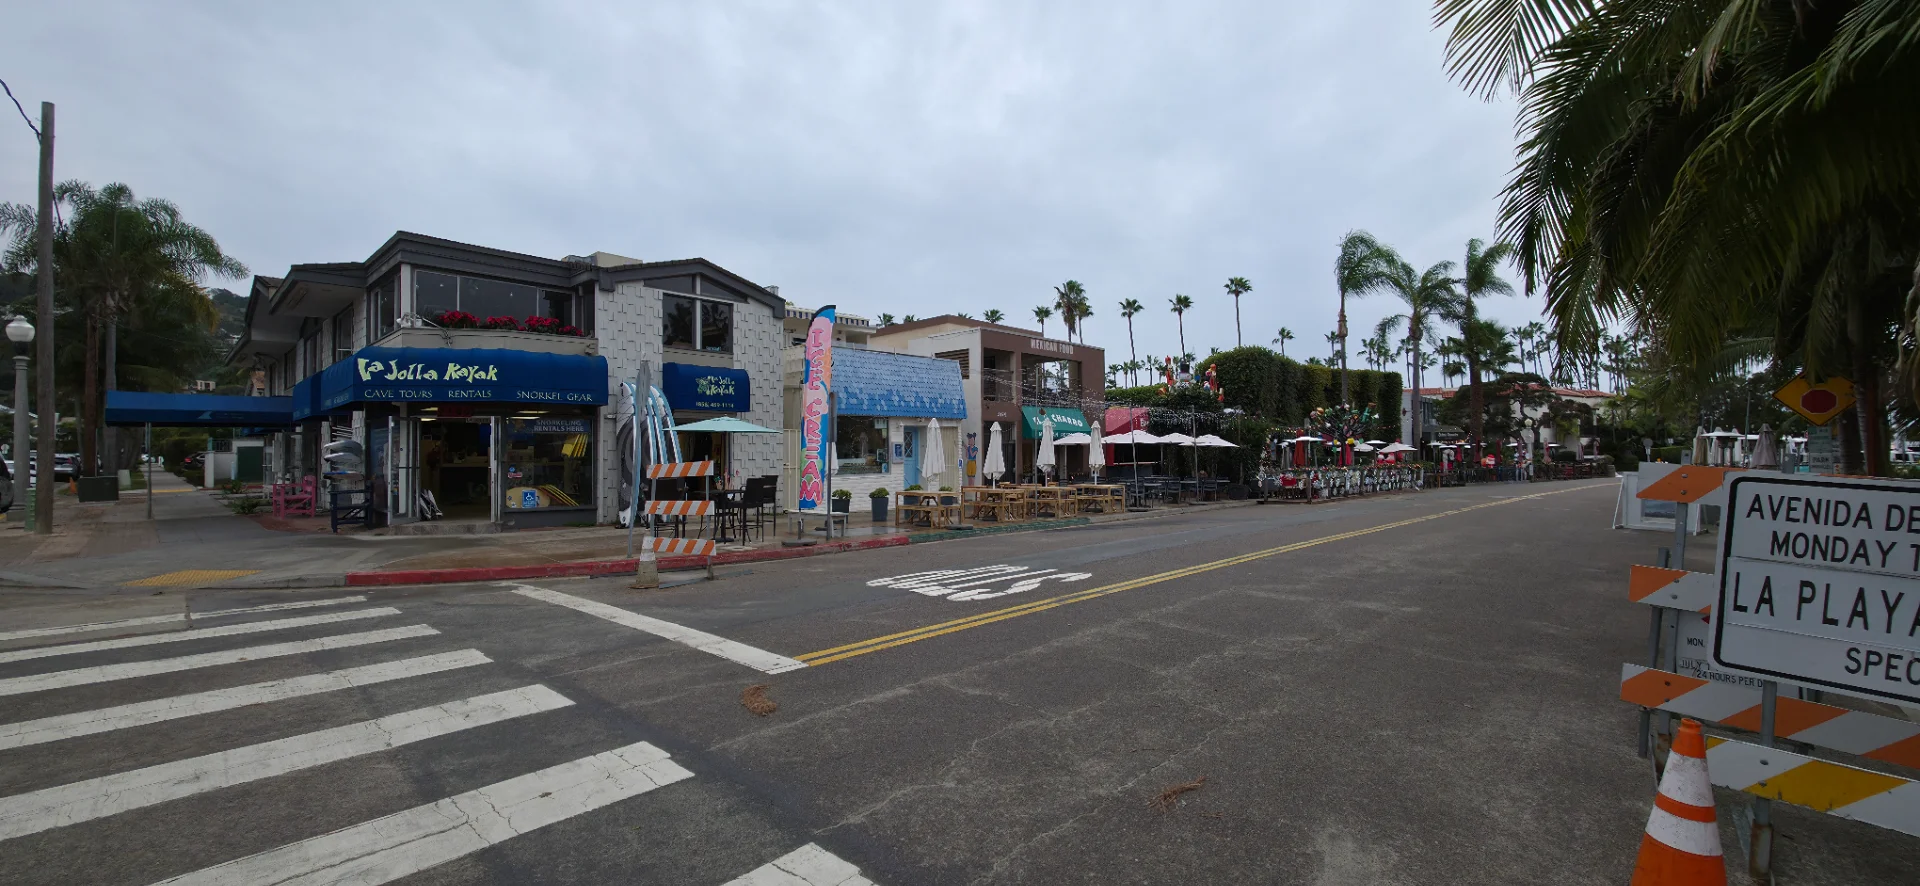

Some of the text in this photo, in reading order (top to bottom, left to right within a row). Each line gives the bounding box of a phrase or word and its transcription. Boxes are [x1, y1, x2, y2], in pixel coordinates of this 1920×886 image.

[1030, 338, 1074, 354] MEXICAN FOOD
[357, 357, 498, 384] La Jolla Kayak
[364, 389, 593, 402] CAVE TOURS RENTALS SNORKEL GEAR
[800, 329, 824, 502] ICE CREAM
[1051, 413, 1083, 427] CHARRO
[1745, 493, 1873, 530] AVENIDA
[1770, 530, 1897, 568] MONDAY
[1732, 571, 1775, 617] LA
[1709, 671, 1737, 684] HOURS
[1738, 676, 1755, 687] PER
